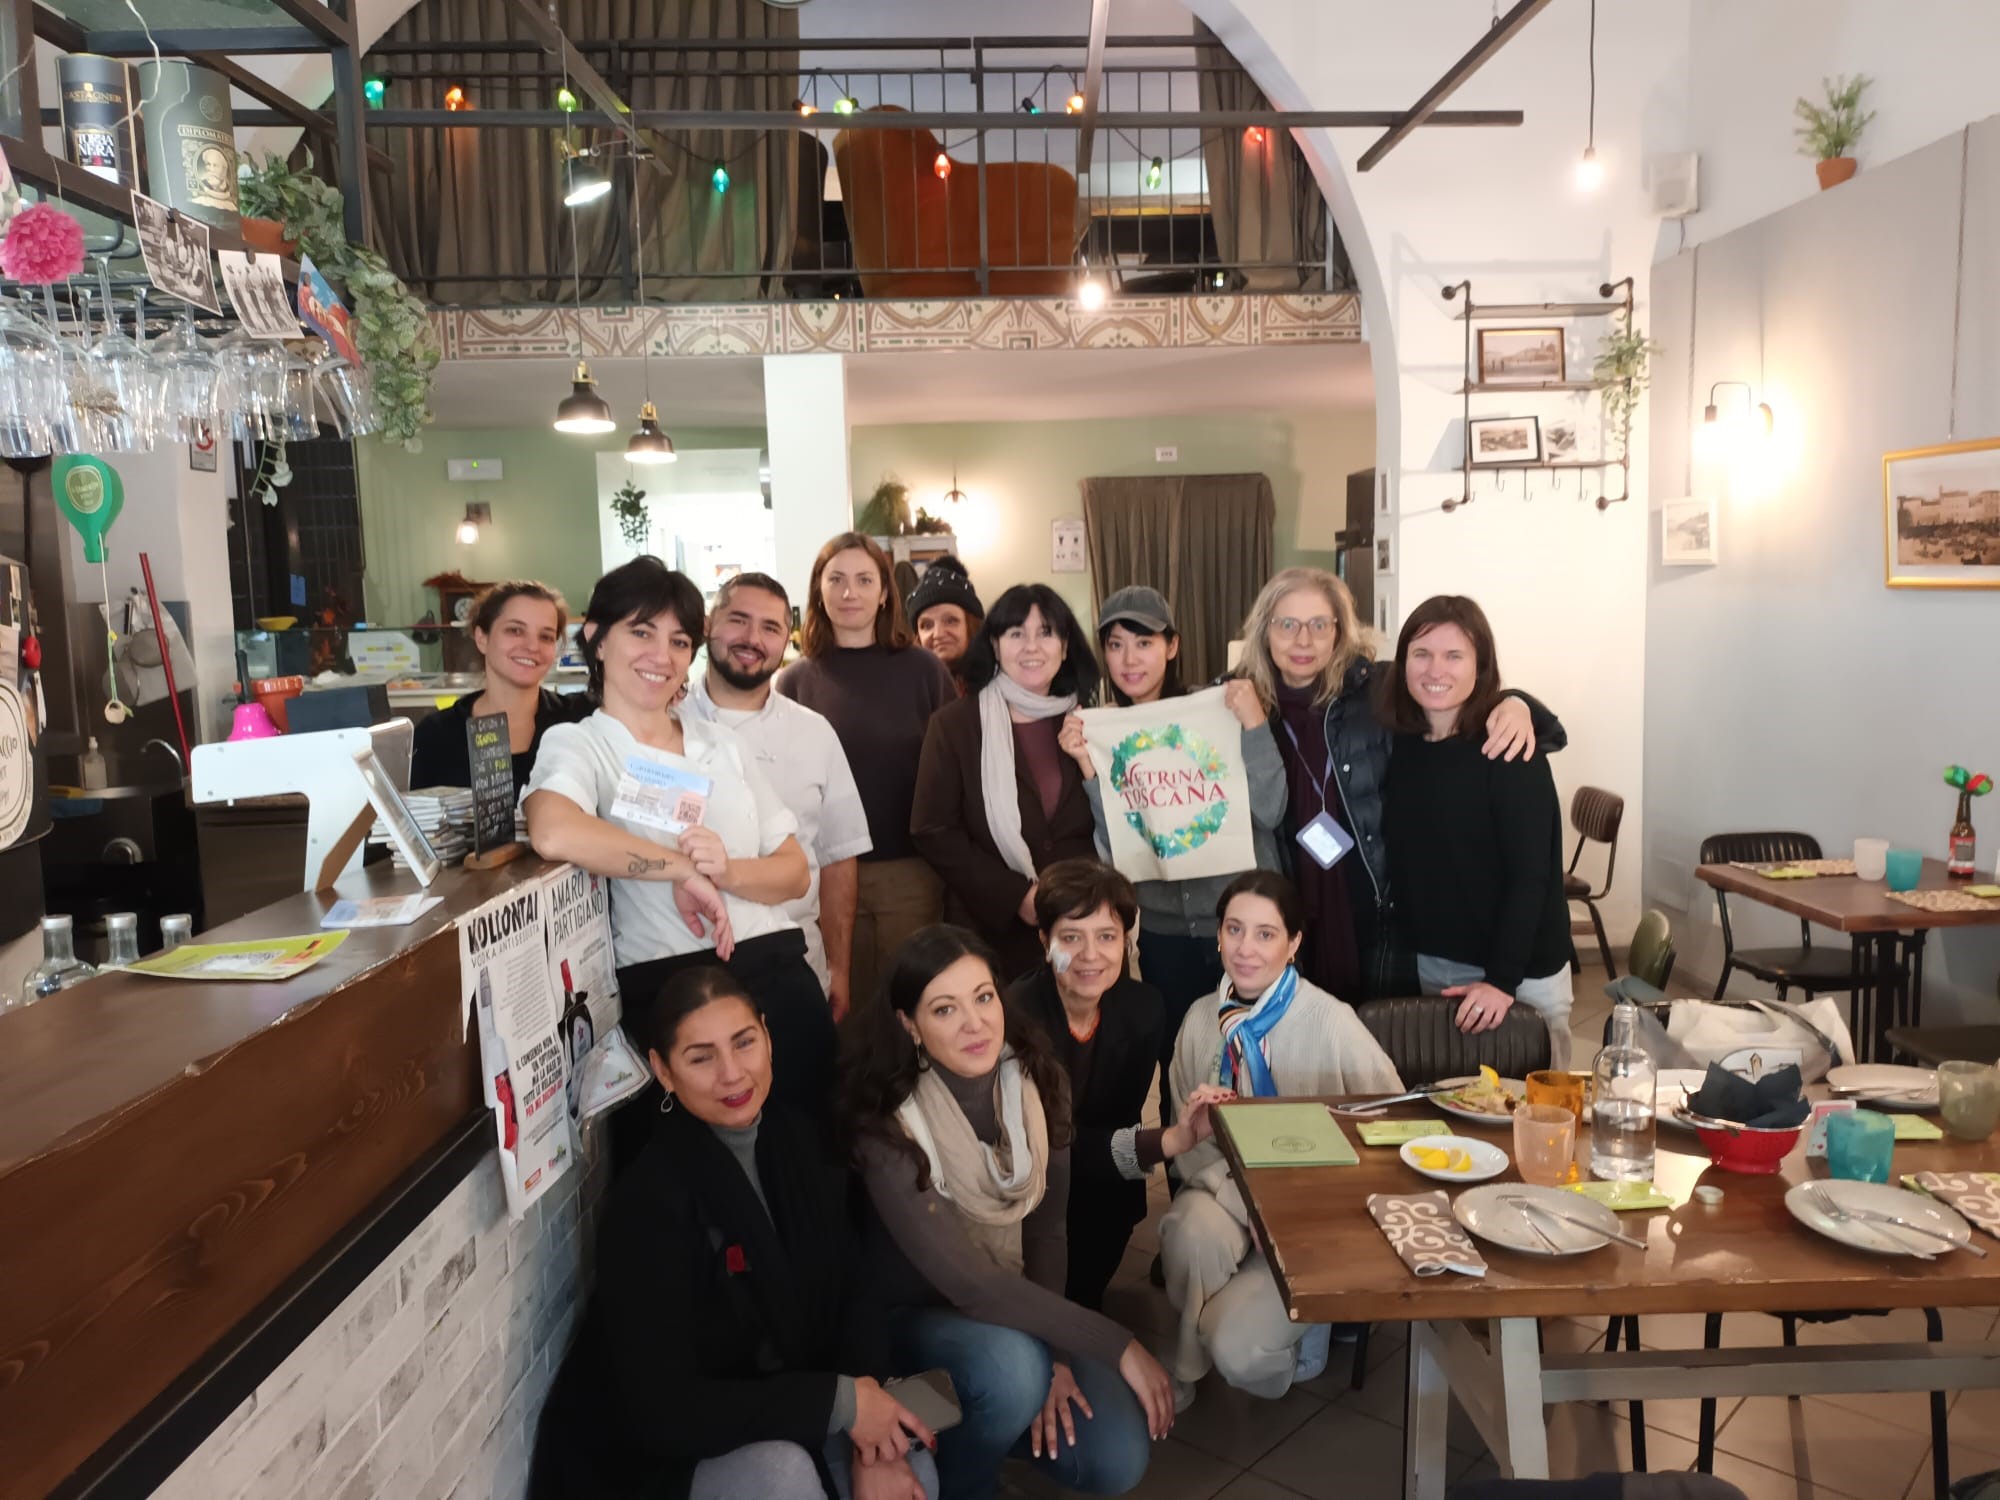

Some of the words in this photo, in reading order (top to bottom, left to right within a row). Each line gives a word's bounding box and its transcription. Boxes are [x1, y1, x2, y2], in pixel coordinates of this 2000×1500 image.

[78, 144, 114, 158] NERA
[1123, 762, 1206, 789] VETRINA
[1120, 782, 1226, 810] TOSCANA
[551, 870, 584, 917] AMARO
[467, 891, 538, 954] KOLLONTAI
[553, 890, 603, 949] PARTIGIANO
[471, 948, 497, 969] VODKA
